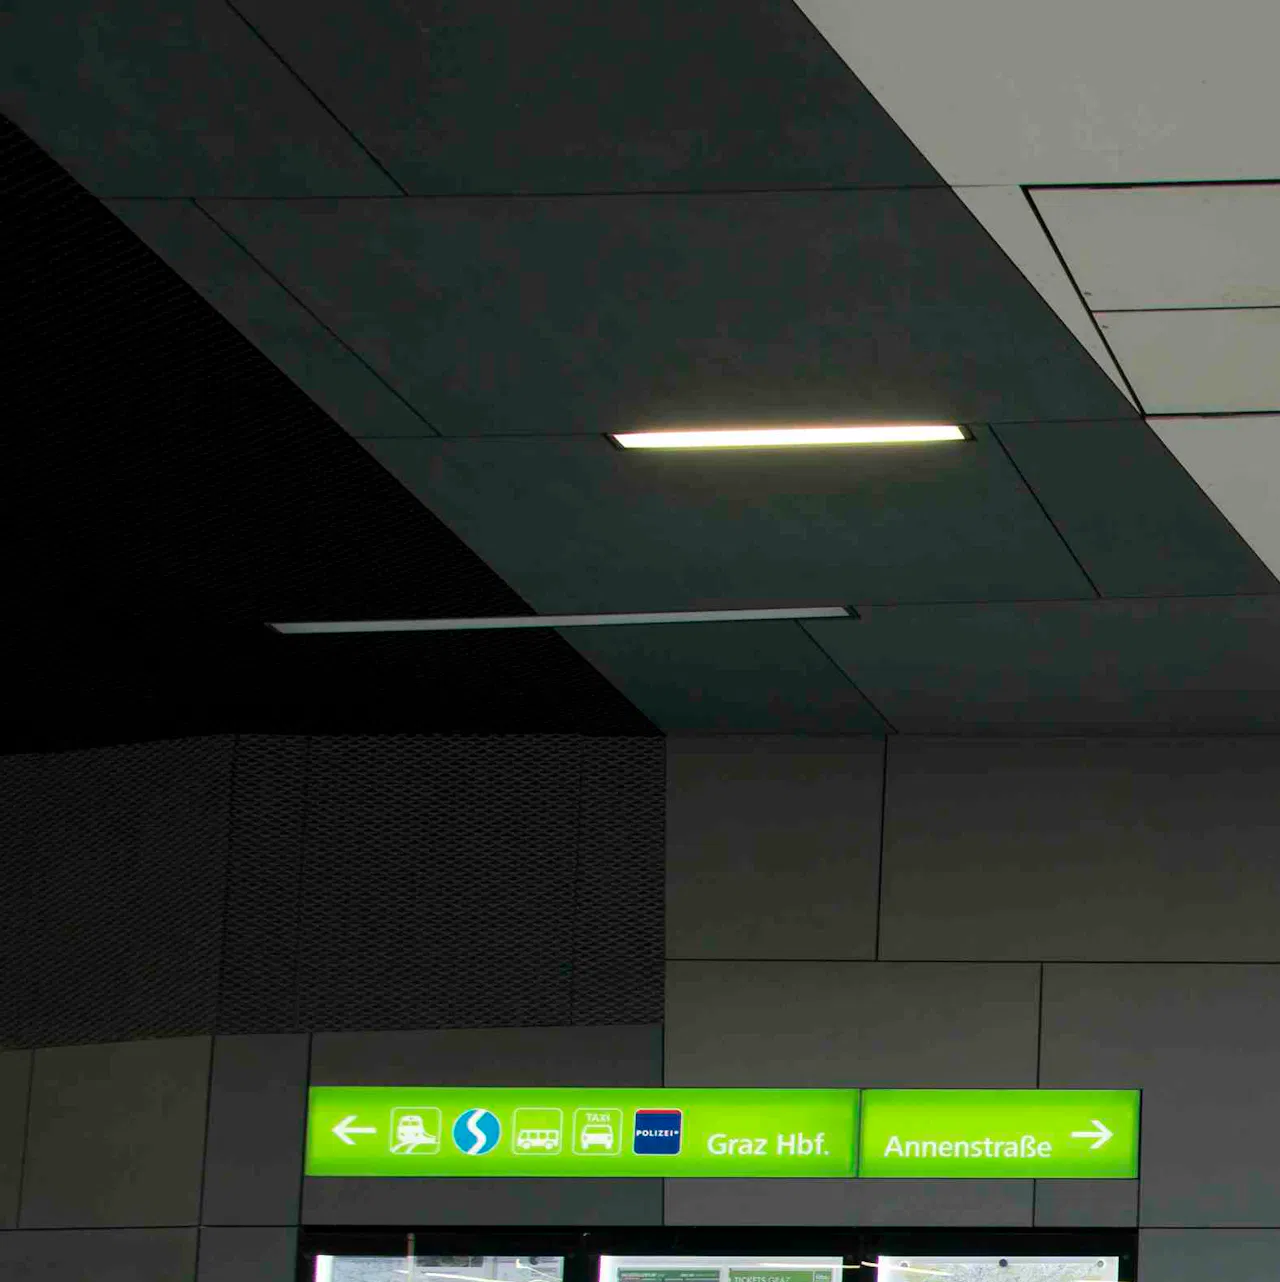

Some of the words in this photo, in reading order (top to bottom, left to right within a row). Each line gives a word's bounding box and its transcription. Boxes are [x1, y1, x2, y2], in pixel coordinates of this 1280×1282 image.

[585, 1112, 611, 1123] TAXI
[707, 1133, 767, 1156] Graz
[776, 1133, 830, 1157] Hbf.
[884, 1136, 1052, 1159] Annenstraße
